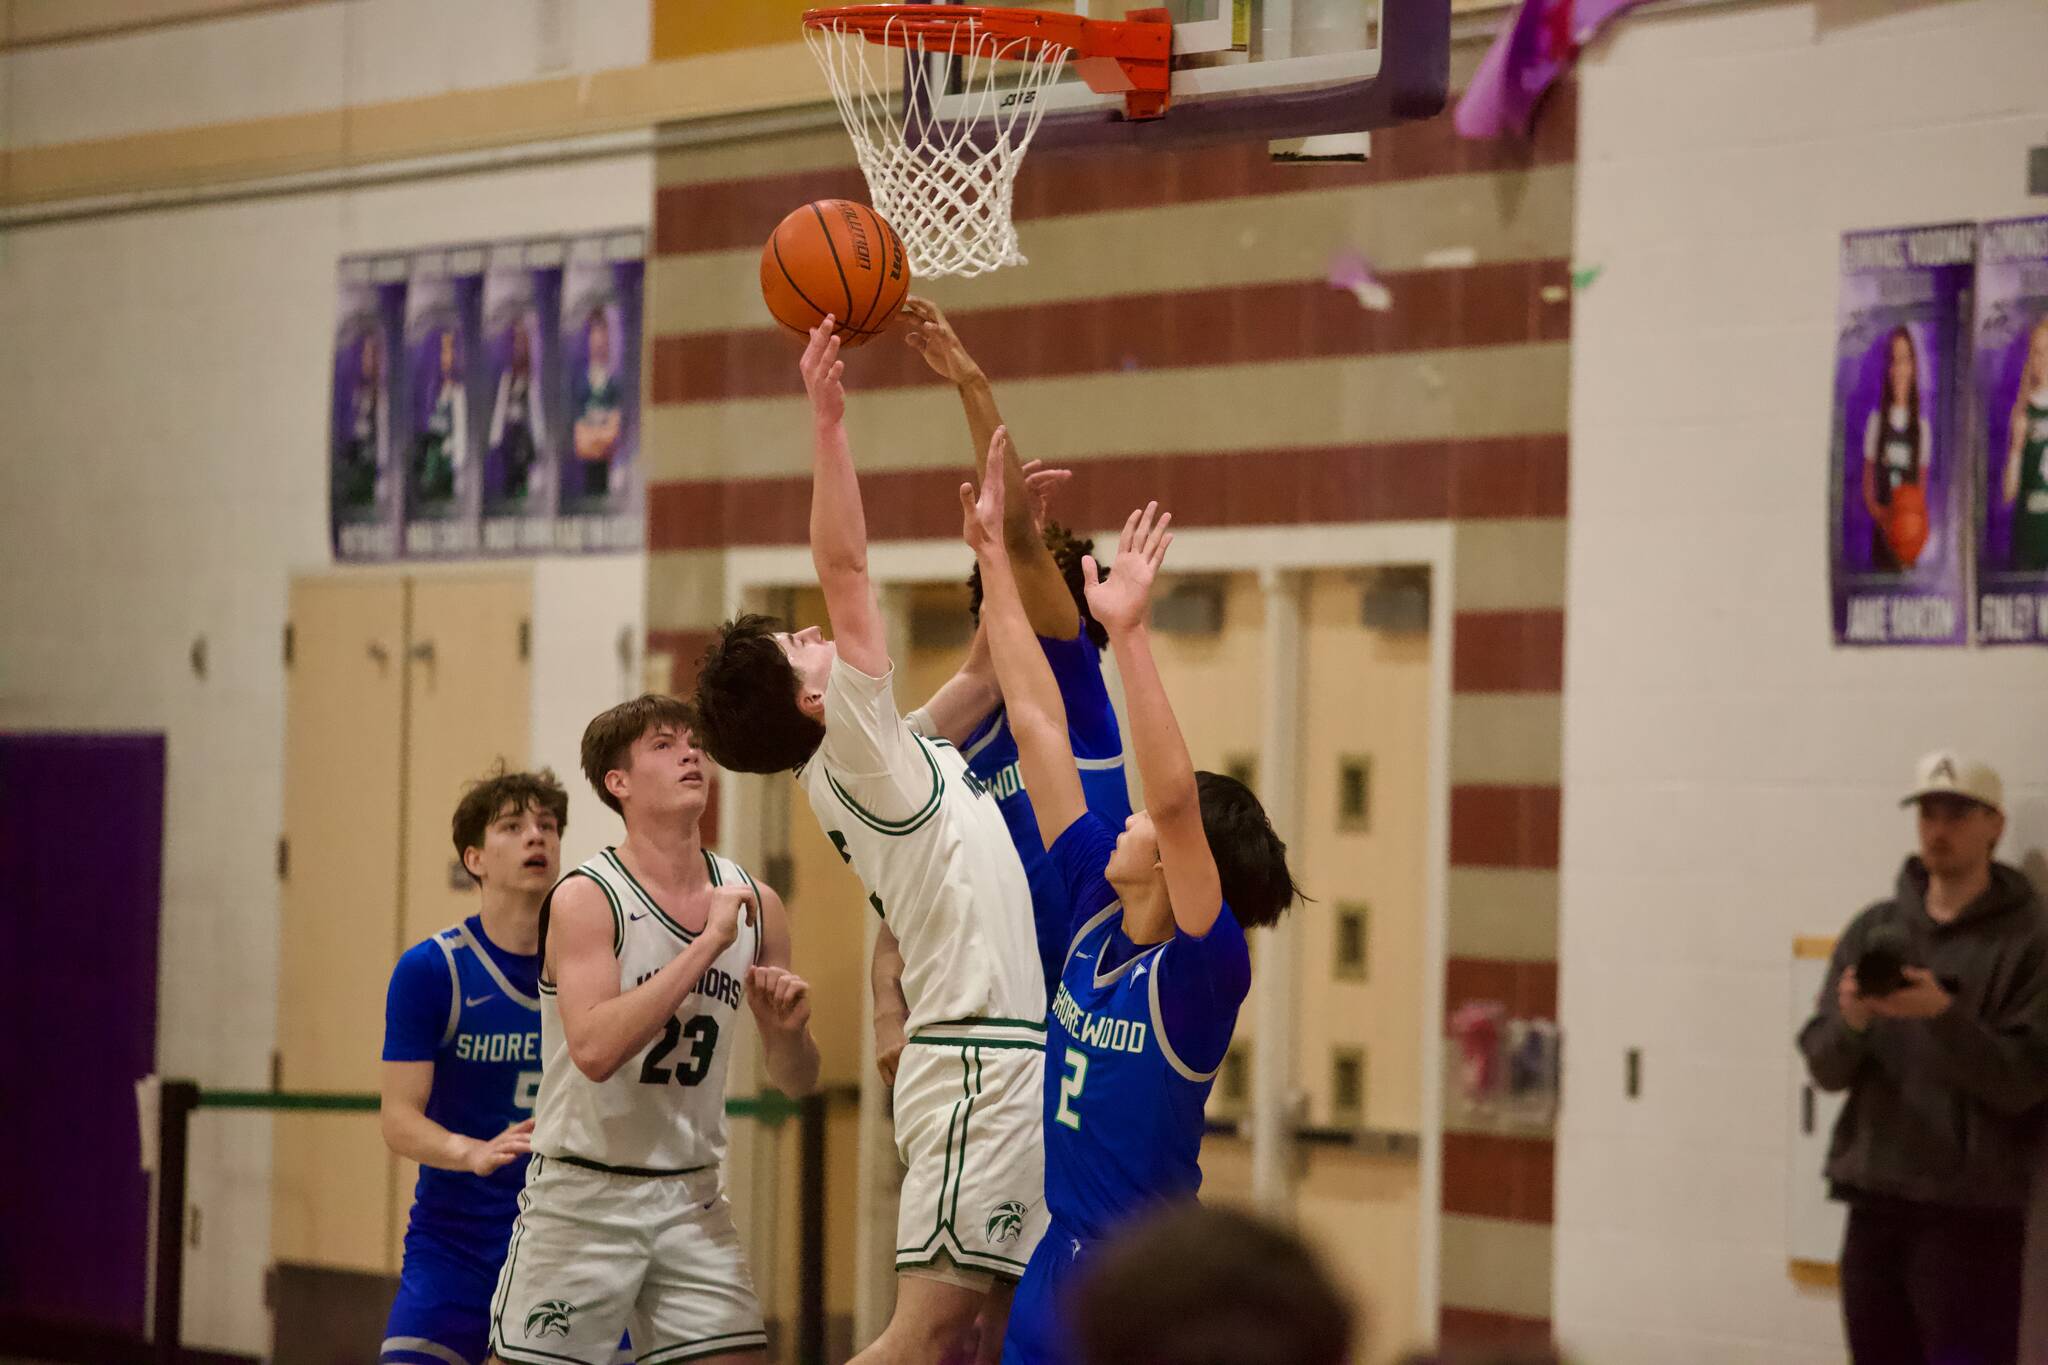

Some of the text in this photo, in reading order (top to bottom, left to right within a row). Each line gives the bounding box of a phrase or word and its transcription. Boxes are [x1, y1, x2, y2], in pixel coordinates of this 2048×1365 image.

[1928, 757, 1957, 782] A
[456, 1033, 539, 1063] SHORE
[639, 1014, 720, 1087] 23
[1052, 979, 1147, 1054] SHOREWOOD
[1056, 1047, 1090, 1130] 2
